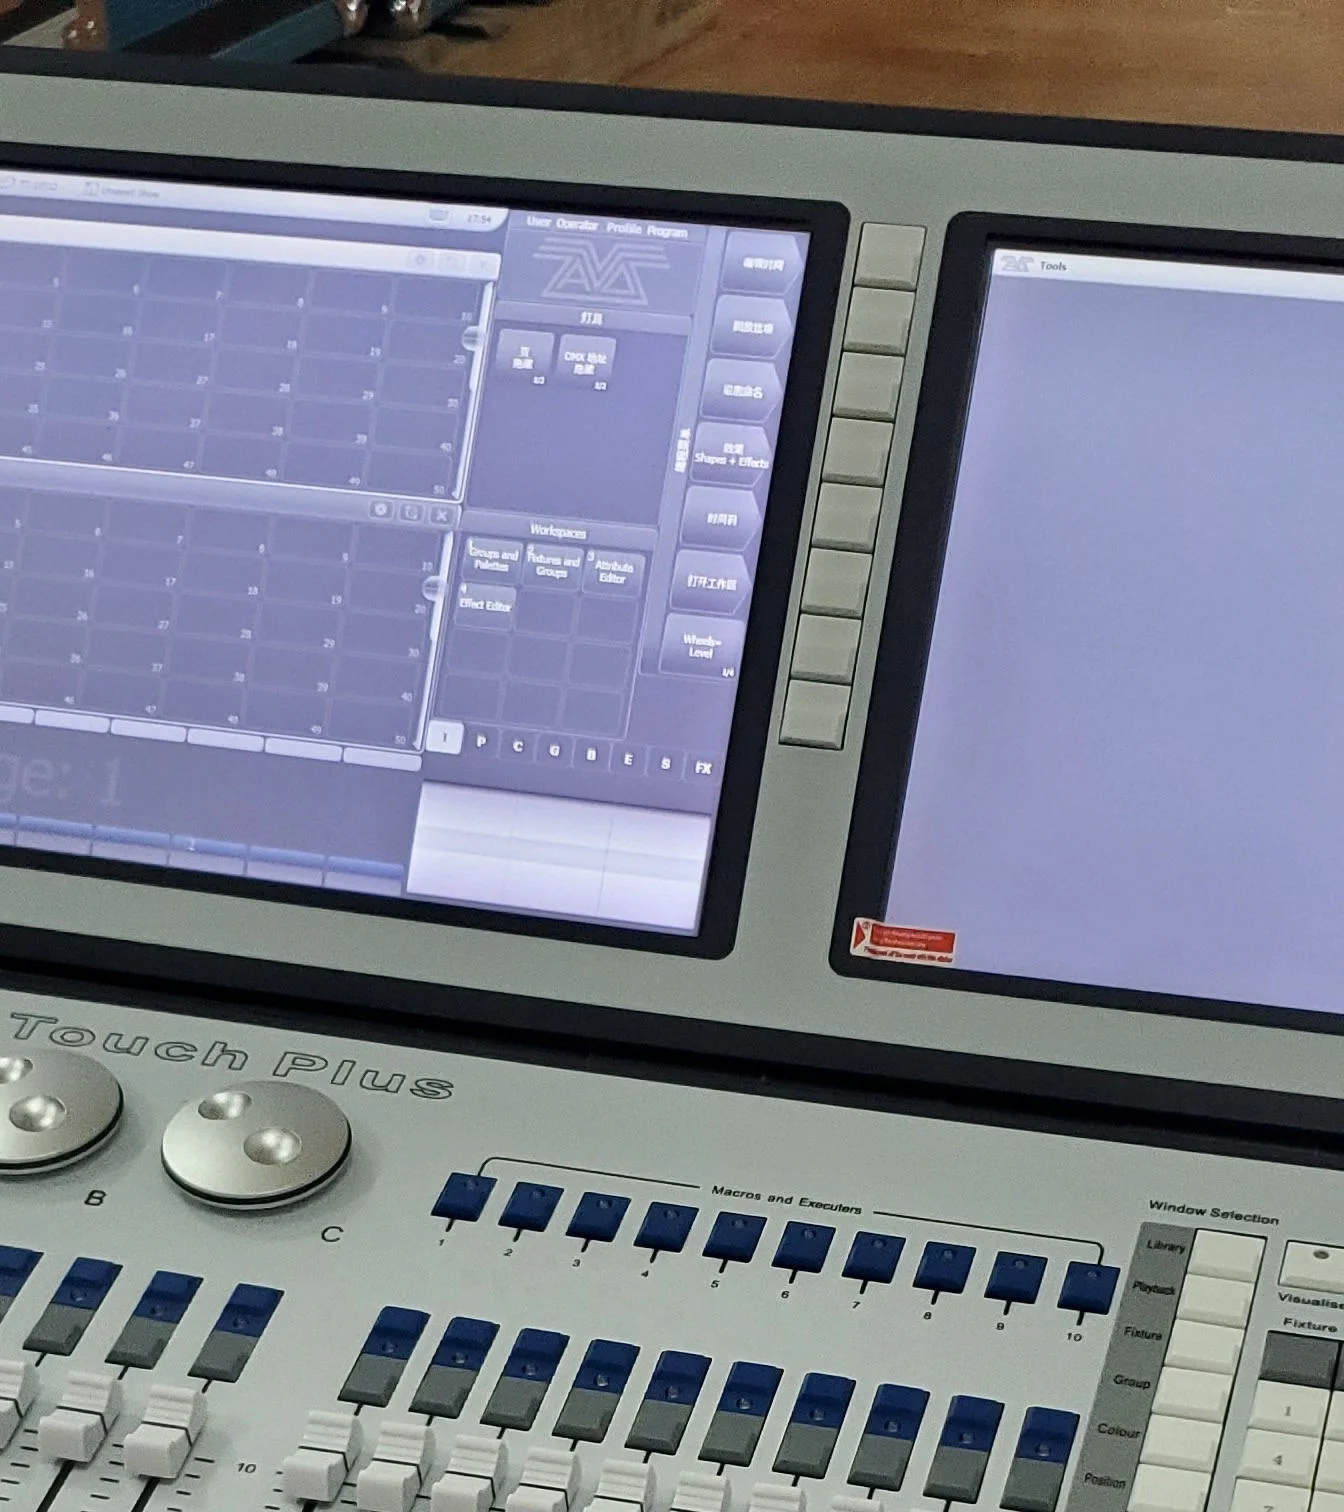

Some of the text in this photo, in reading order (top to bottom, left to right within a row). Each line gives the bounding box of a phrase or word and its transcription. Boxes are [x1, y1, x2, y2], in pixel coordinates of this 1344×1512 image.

[527, 215, 688, 239] User Operator Profile Program
[1040, 260, 1067, 272] Tools
[530, 523, 587, 540] Workspaces
[595, 560, 634, 573] Attribute
[599, 573, 626, 584] Editor
[459, 600, 512, 612] Effect Editor
[689, 646, 713, 659] Level
[695, 762, 712, 774] FX
[102, 757, 122, 804] 1
[10, 1012, 250, 1069] Touch
[275, 1051, 456, 1100] Plus
[712, 1185, 862, 1215] Macros and Executers
[84, 1191, 106, 1206] B
[321, 1227, 344, 1242] C
[1150, 1200, 1279, 1226] Window Selection
[1147, 1241, 1185, 1255] Library
[504, 1248, 513, 1256] 2
[572, 1259, 581, 1267] 3
[640, 1269, 649, 1278] 4
[710, 1280, 720, 1289] 5
[781, 1291, 789, 1299] 6
[853, 1301, 860, 1309] 7
[924, 1311, 932, 1319] 8
[996, 1322, 1004, 1330] 9
[1067, 1332, 1082, 1341] 10
[1284, 1317, 1337, 1333] Fixture
[1125, 1327, 1162, 1341] Fixture
[1114, 1374, 1150, 1390] Group
[1284, 1406, 1291, 1417] 1
[1098, 1423, 1140, 1439] Colour
[236, 1463, 256, 1472] 10
[1273, 1454, 1282, 1466] 4
[1084, 1473, 1126, 1490] Position
